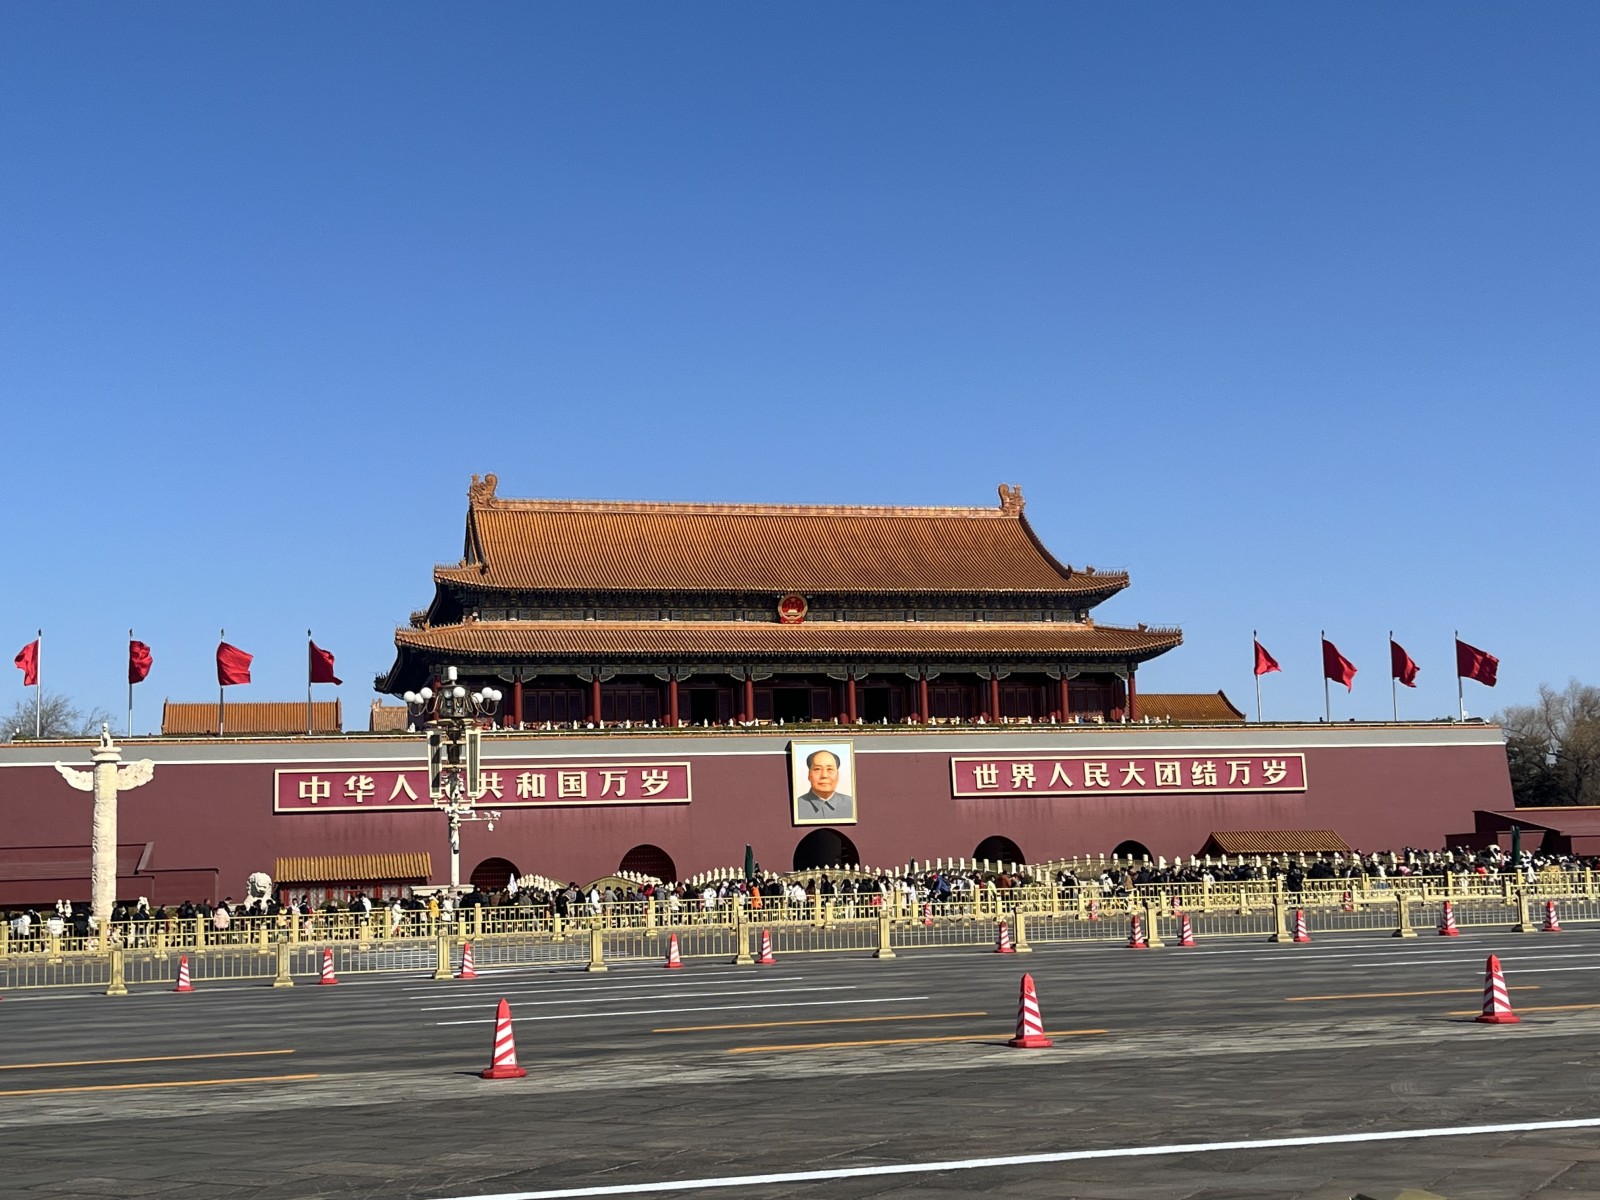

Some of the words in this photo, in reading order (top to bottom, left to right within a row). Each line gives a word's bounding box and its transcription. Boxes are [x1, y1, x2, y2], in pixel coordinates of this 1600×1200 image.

[973, 760, 1287, 789] 世界人民大团结万岁
